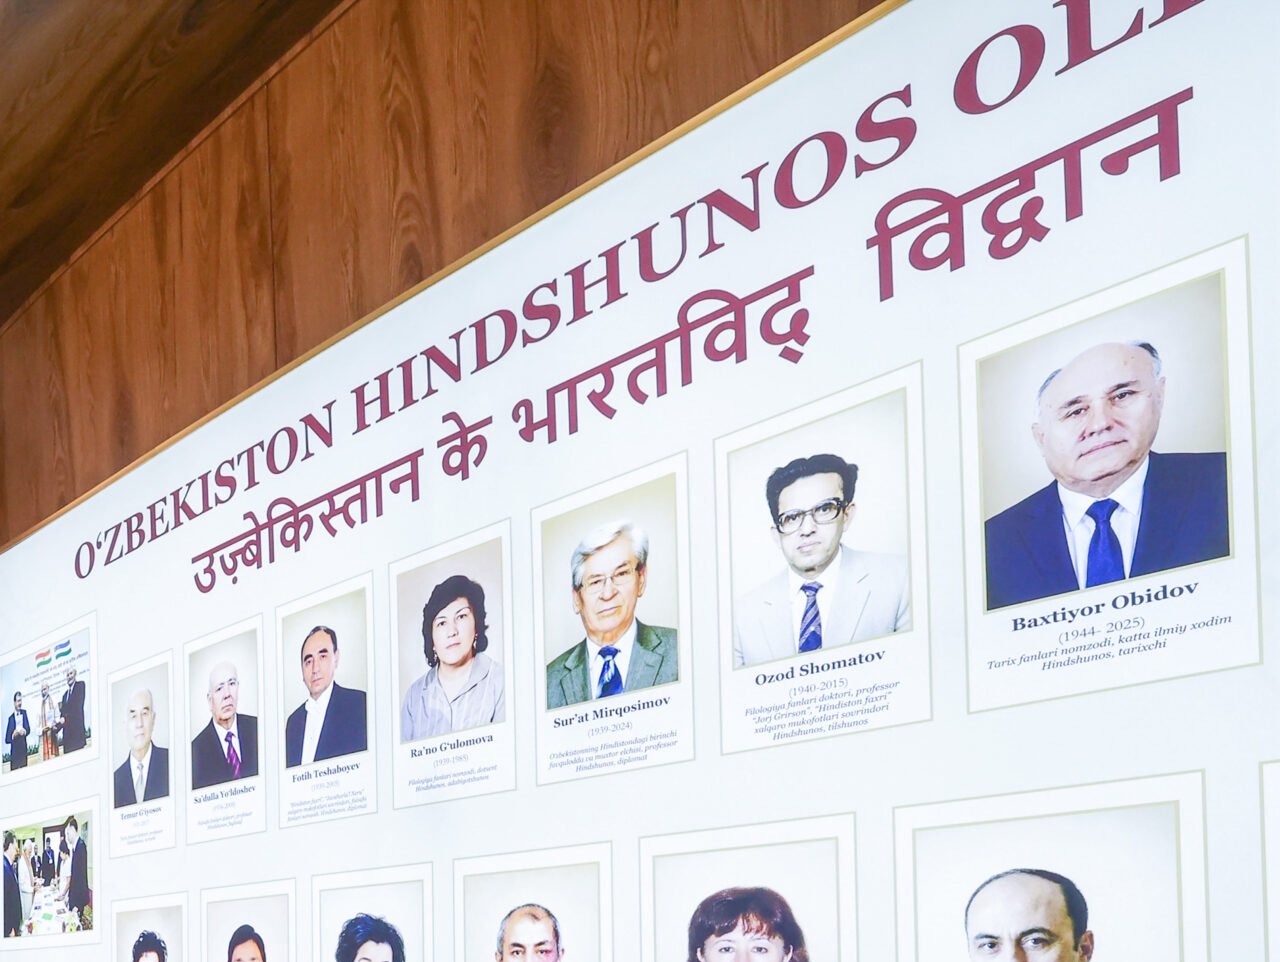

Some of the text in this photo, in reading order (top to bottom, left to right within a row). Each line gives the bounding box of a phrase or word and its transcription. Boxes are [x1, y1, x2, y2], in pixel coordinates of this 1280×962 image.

[352, 83, 917, 435] HINDSHUNOS
[953, 0, 1207, 115] OL
[436, 411, 493, 481] के
[513, 266, 813, 443] भारतविद्
[866, 87, 1194, 302] विद्वान
[1011, 582, 1200, 632] Baxtiyor Obidov
[986, 614, 1232, 670] Tarix fanlari nomzodi, katta ilmiy xodim
[1106, 617, 1146, 634] 2025)
[755, 650, 886, 686] Ozod Shomatov
[1042, 638, 1167, 671] Hindshunos, tarixchi
[745, 680, 900, 717] Filologiya fanlari doktori, professor
[789, 677, 849, 699] (1940-2015)
[592, 696, 671, 720] Mirqosimov
[754, 703, 889, 735] xalqaro mukofotlari sovrindori
[772, 717, 869, 741] Hindshunos, tilshunos
[292, 762, 361, 783] Fotih Teshaboyev
